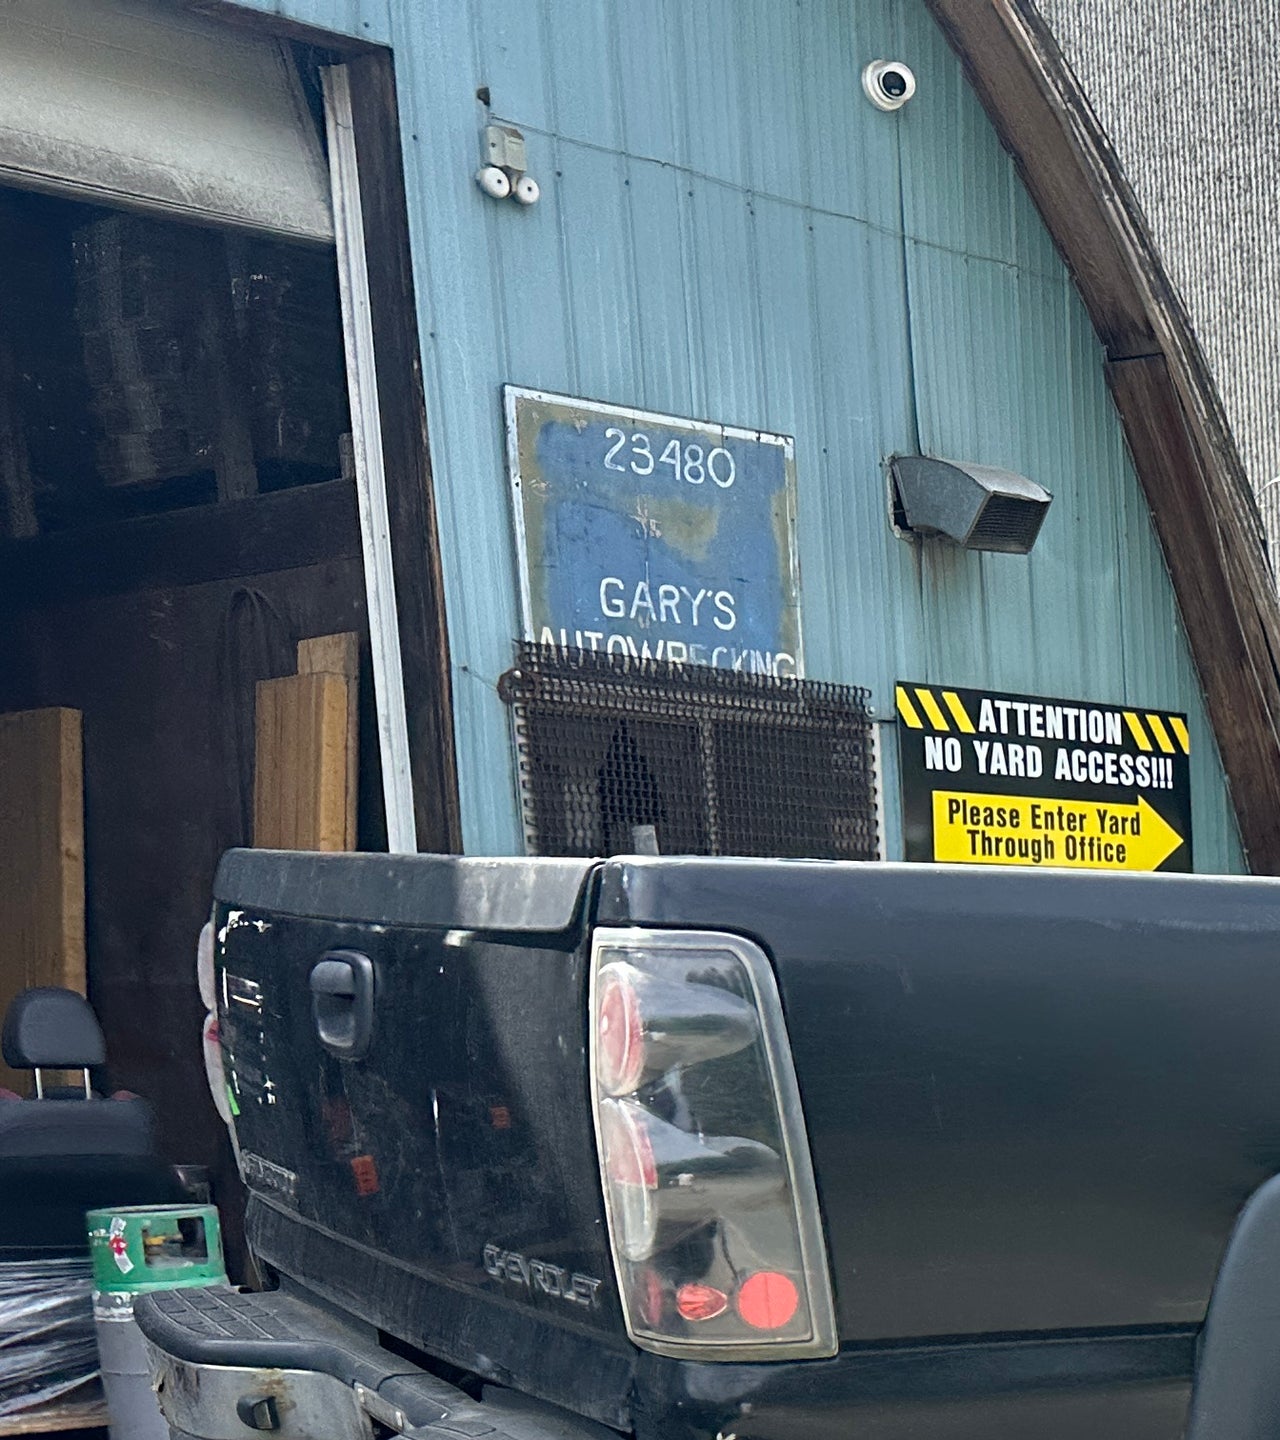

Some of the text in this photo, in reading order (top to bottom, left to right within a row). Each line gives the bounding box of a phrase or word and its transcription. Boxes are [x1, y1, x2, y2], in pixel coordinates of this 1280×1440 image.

[604, 427, 736, 488] 23480
[600, 577, 736, 631] GARY'S
[978, 698, 1123, 745] ATTENTION
[924, 735, 1174, 789] NO YARD ACCESS!!!
[948, 798, 1141, 836] Please Enter Yard
[966, 828, 1127, 863] Through Office
[483, 1243, 602, 1308] CHEVROLET
